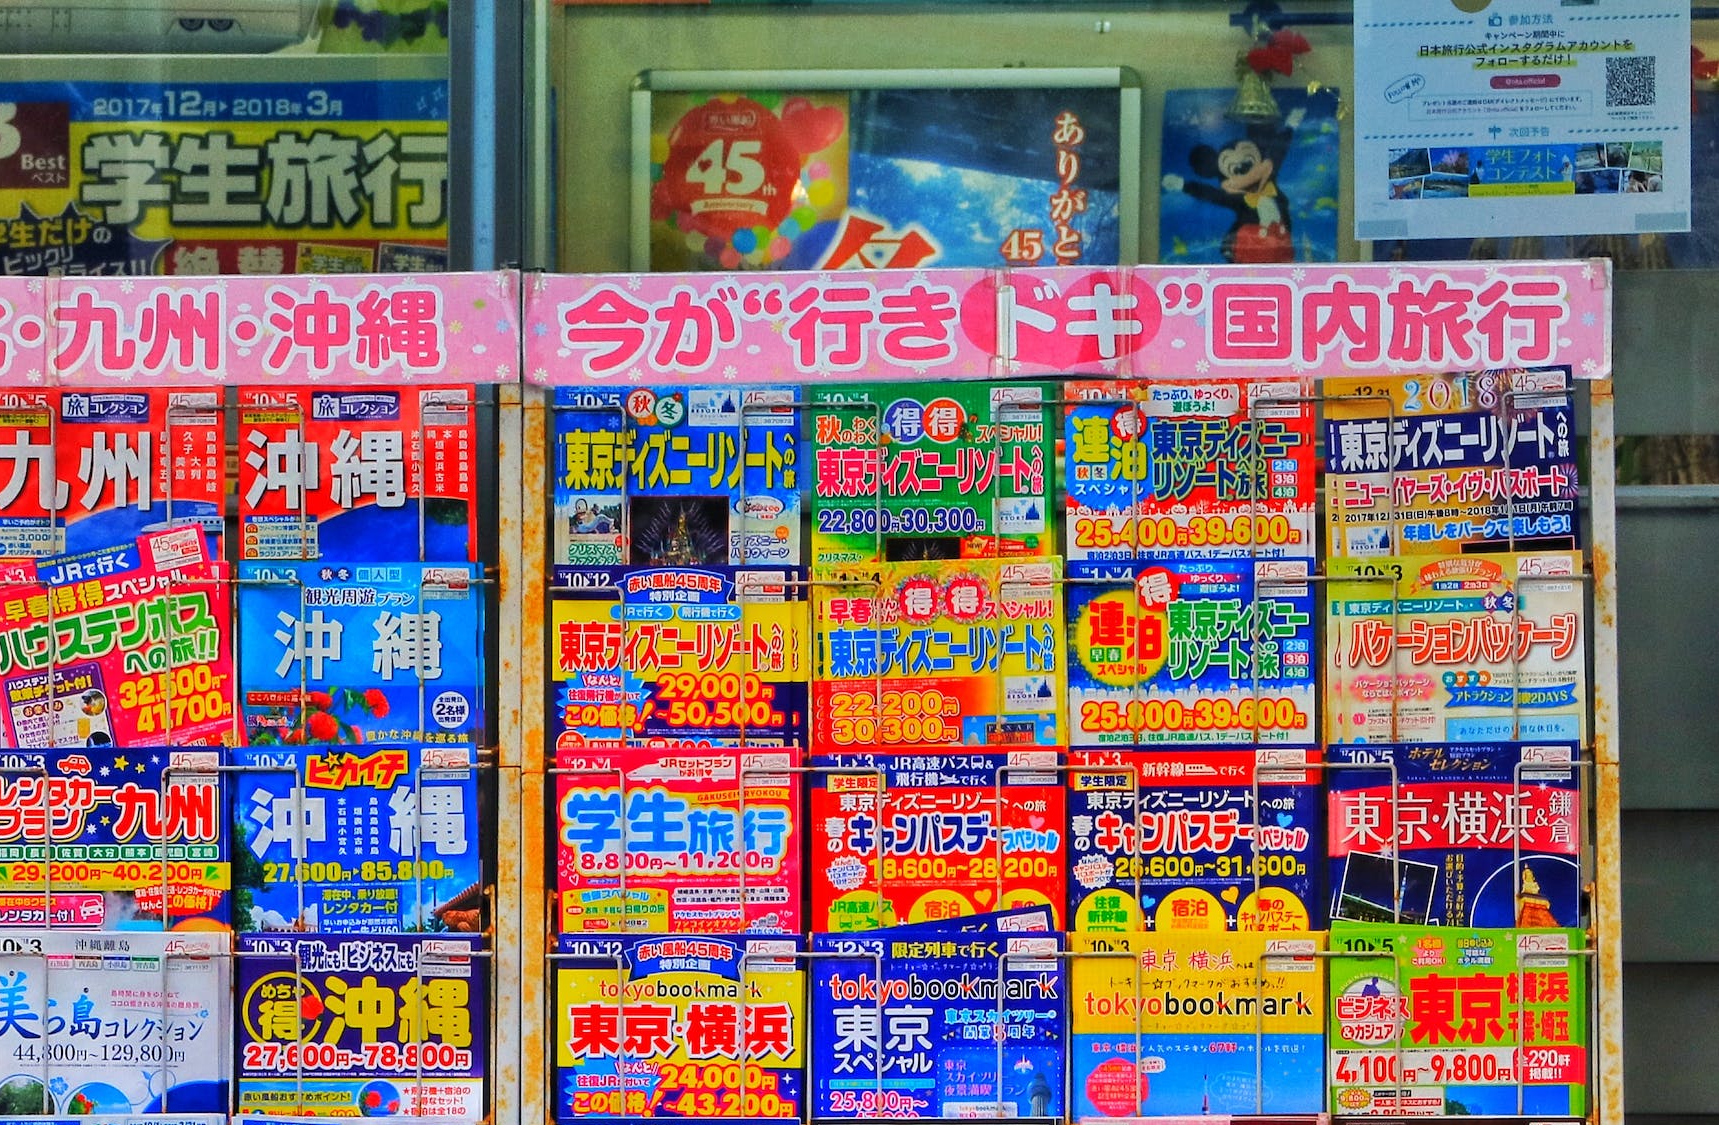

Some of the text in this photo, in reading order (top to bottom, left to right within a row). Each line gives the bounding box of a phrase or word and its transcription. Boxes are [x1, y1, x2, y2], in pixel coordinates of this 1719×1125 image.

[21, 153, 66, 171] Best
[31, 172, 67, 184] ベスト
[83, 131, 447, 226] 学生旅行
[245, 429, 406, 509] 沖縄
[305, 588, 415, 607] 観光周遊プラン
[628, 575, 722, 594] 赤い風船45周年
[275, 610, 442, 680] 沖縄
[307, 752, 407, 788] ピカイチ
[566, 790, 787, 856] 学生旅行
[75, 939, 130, 952] 沖縄離島
[830, 974, 1058, 1005] tokyobookmark
[1085, 989, 1312, 1020] tokyobookmark
[323, 975, 472, 1047] 沖縄
[568, 1004, 794, 1059] 東京・横浜
